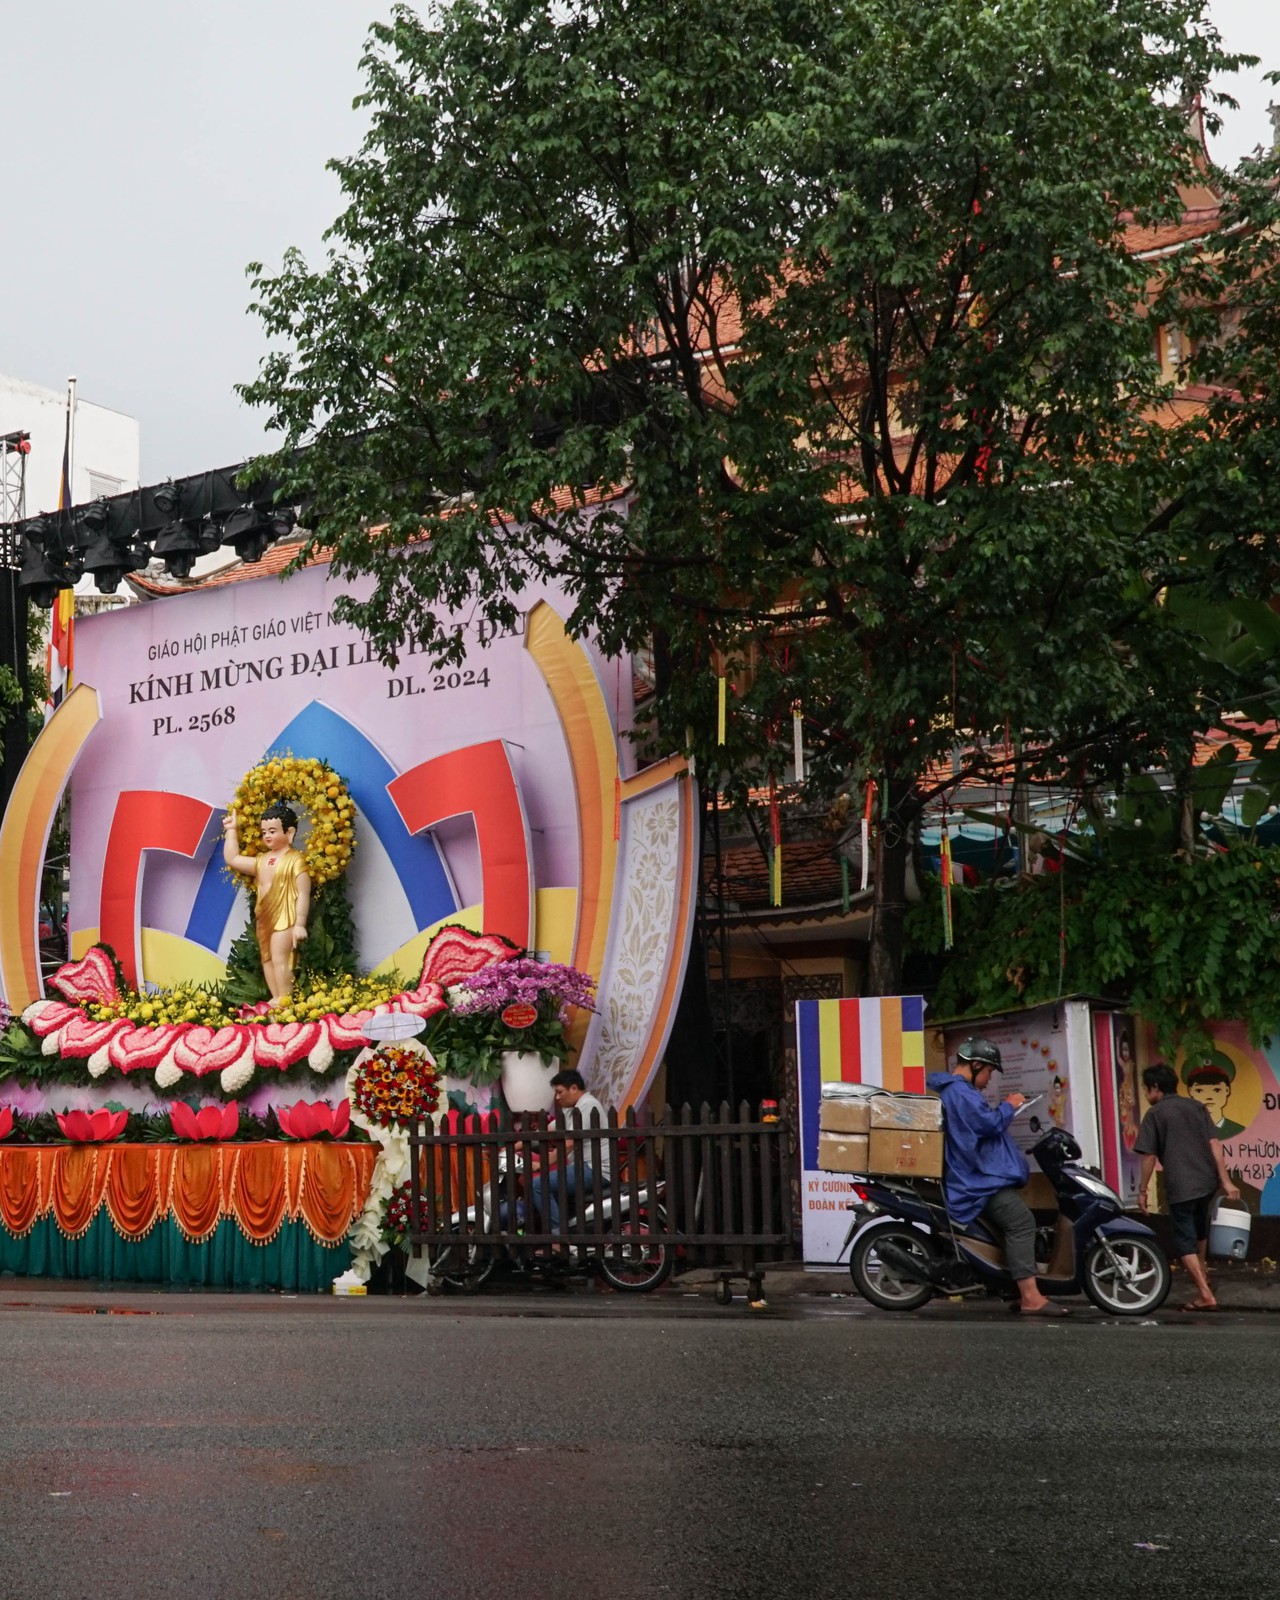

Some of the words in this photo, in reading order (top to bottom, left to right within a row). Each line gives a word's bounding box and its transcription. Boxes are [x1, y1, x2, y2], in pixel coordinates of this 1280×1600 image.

[148, 639, 180, 661] GIÁO
[184, 633, 207, 655] HỘI
[211, 626, 249, 649] PHẬT
[252, 618, 286, 641] GIÁO
[291, 611, 323, 634] VIỆT
[129, 674, 193, 704] KÍNH
[200, 659, 285, 691] MỪNG
[291, 646, 340, 677] ĐẠI
[387, 676, 426, 698] DL.
[433, 667, 491, 691] 2024
[152, 716, 183, 736] PL.
[188, 705, 236, 732] 2568
[808, 1198, 836, 1211] ĐOÀN
[838, 1197, 857, 1211] KẾ
